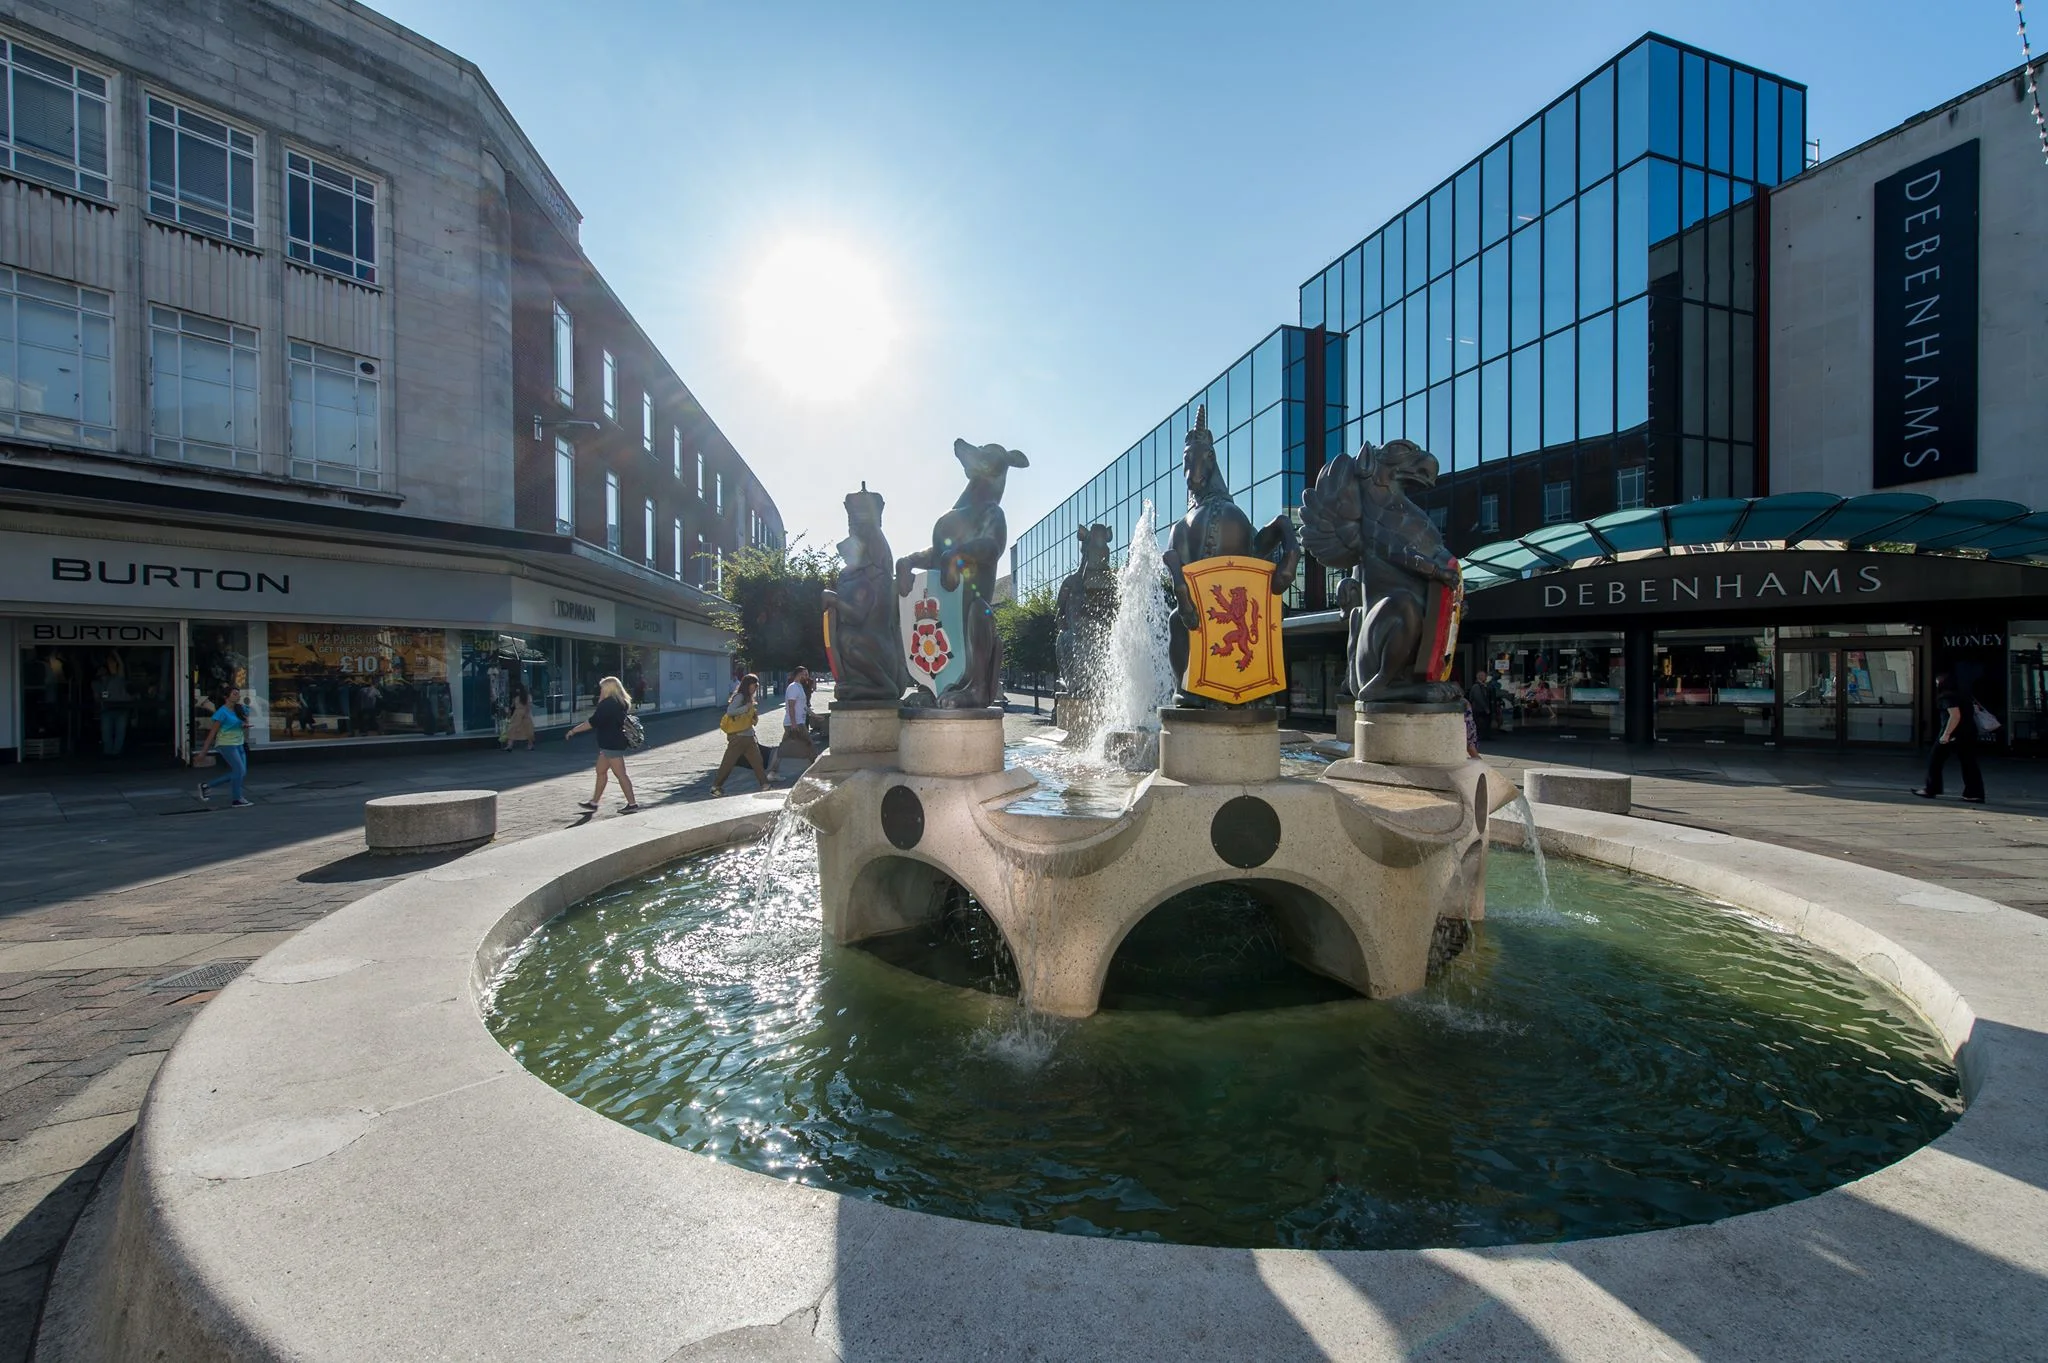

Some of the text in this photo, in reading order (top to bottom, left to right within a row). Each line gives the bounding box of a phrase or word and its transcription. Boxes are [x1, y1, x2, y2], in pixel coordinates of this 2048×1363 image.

[1904, 169, 1941, 468] DEBENHAMS
[51, 557, 290, 595] BURTON
[1544, 565, 1883, 607] DEBENHAMS
[556, 599, 596, 623] TOPMAN
[33, 624, 164, 641] BURTON
[633, 618, 663, 634] BURTON
[298, 632, 320, 644] BUY
[324, 633, 331, 644] 2
[333, 634, 362, 645] PAIRS
[1943, 633, 2005, 648] MONEY
[339, 655, 378, 673] £10
